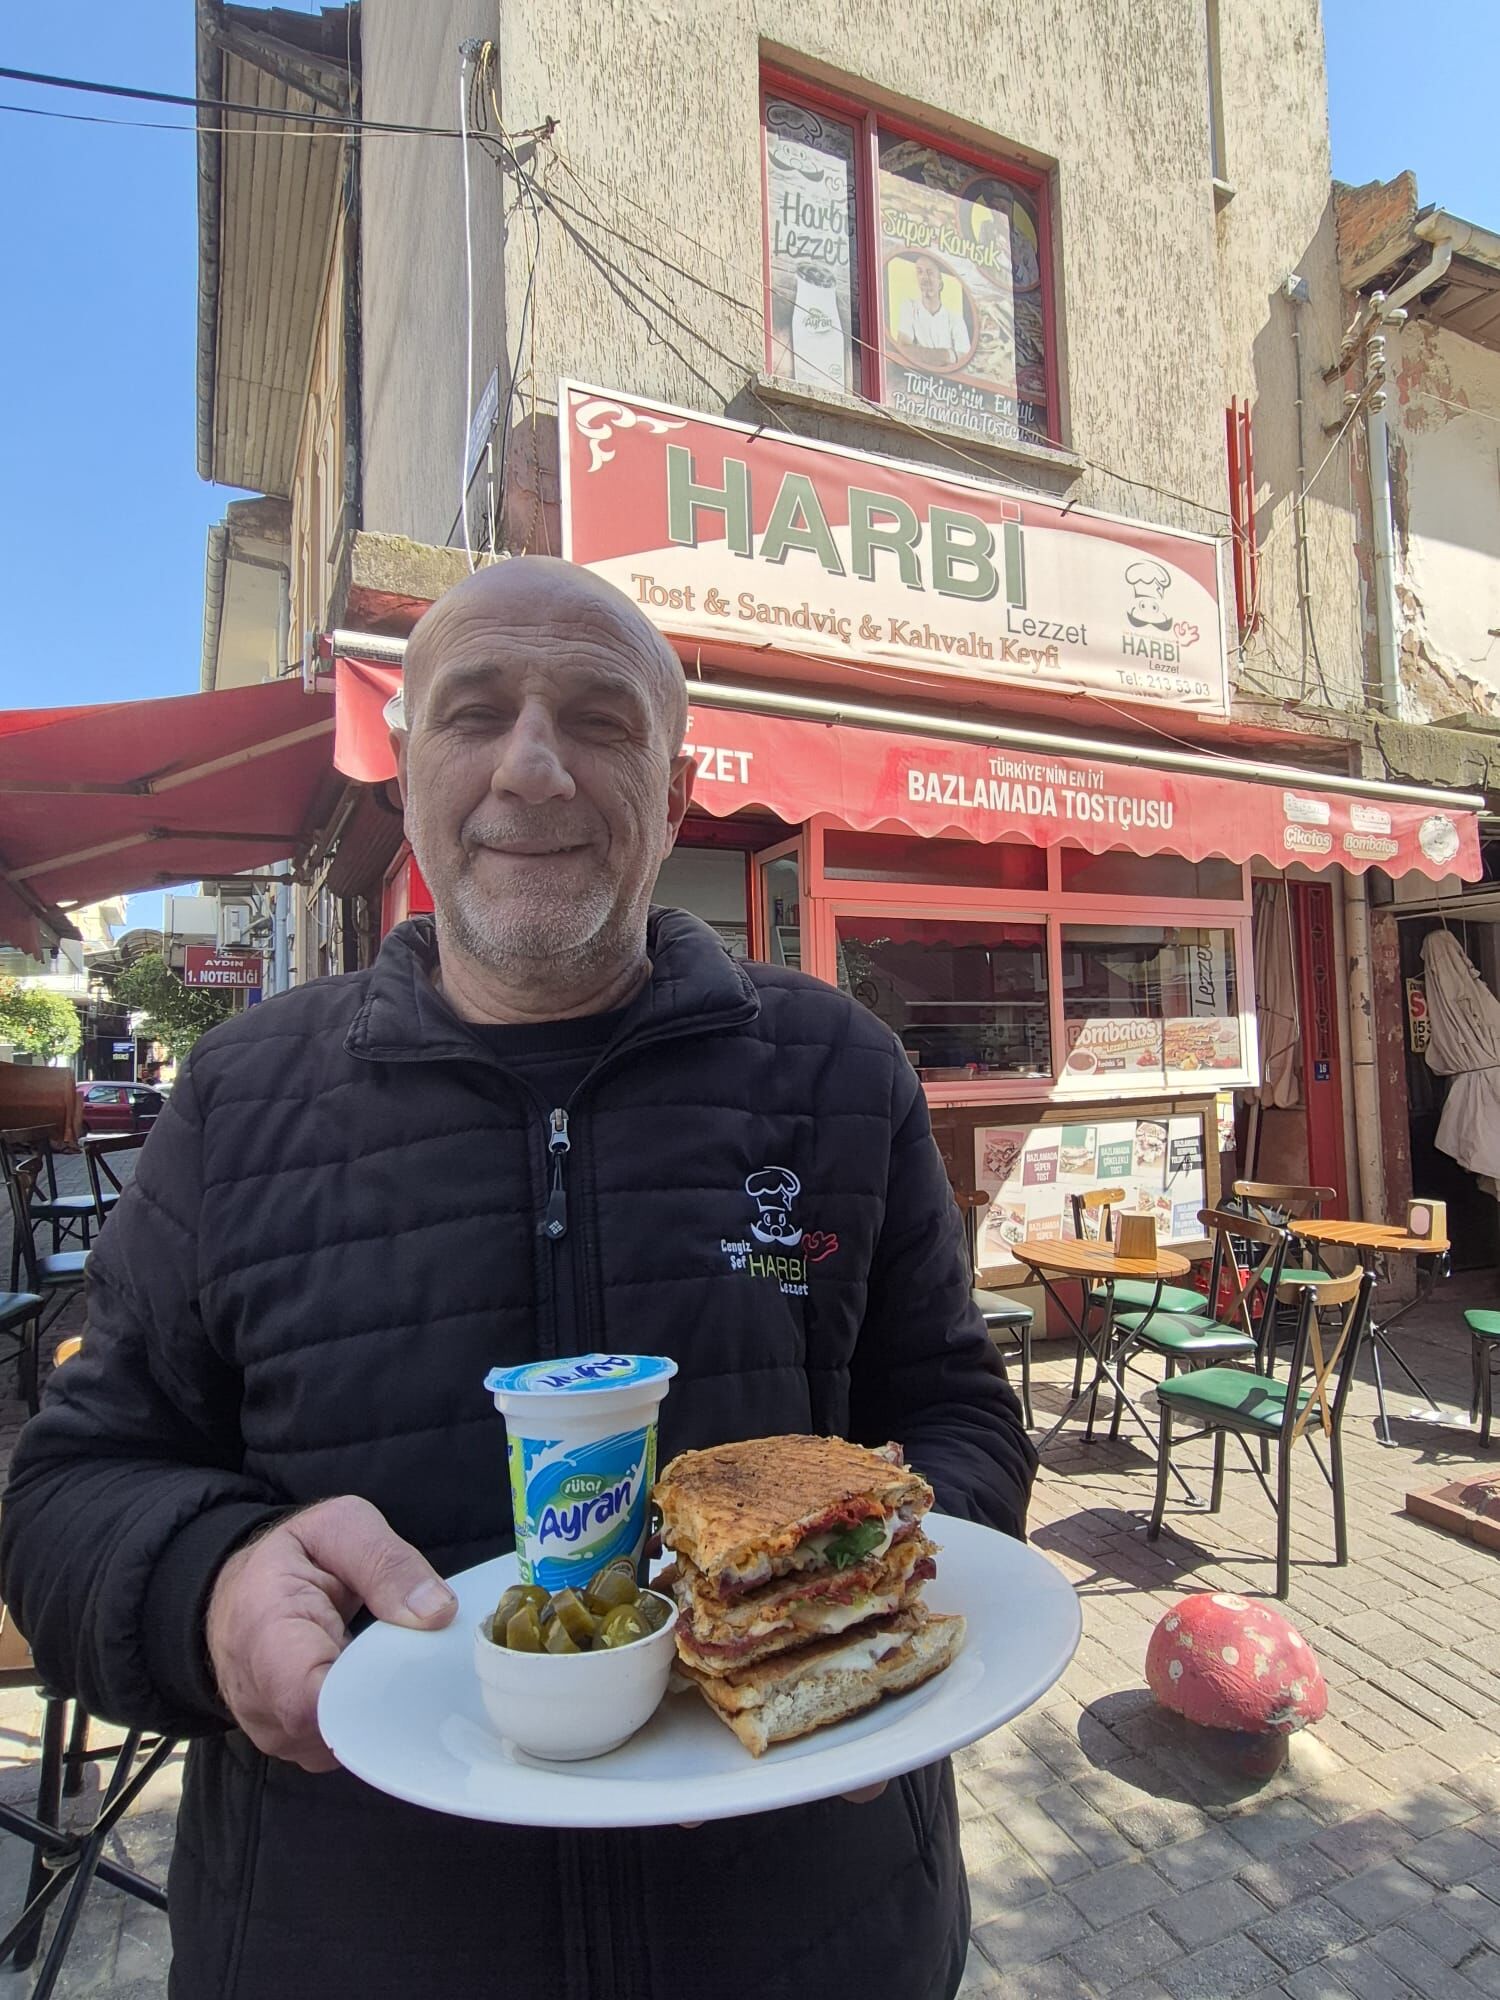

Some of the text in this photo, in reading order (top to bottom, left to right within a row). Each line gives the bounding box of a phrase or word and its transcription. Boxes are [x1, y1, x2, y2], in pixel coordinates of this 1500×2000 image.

[772, 220, 849, 266] Lezzet
[994, 394, 1013, 416] En
[666, 445, 1027, 610] HARBİ
[631, 573, 1061, 674] Tost & Sandviç & Kahvaltı Keyfi
[1006, 608, 1089, 646] Lezzet
[1122, 634, 1180, 663] HARBİ
[988, 756, 1104, 790] TÜRKİYE'NİN EN İYİ
[907, 769, 1173, 831] BAZLAMADA TOSTÇUSU
[187, 968, 258, 985] 1. NOTERLİĞİ
[204, 959, 244, 968] AYDIN
[1195, 943, 1216, 1008] Lezze
[539, 1481, 631, 1545] Ayran
